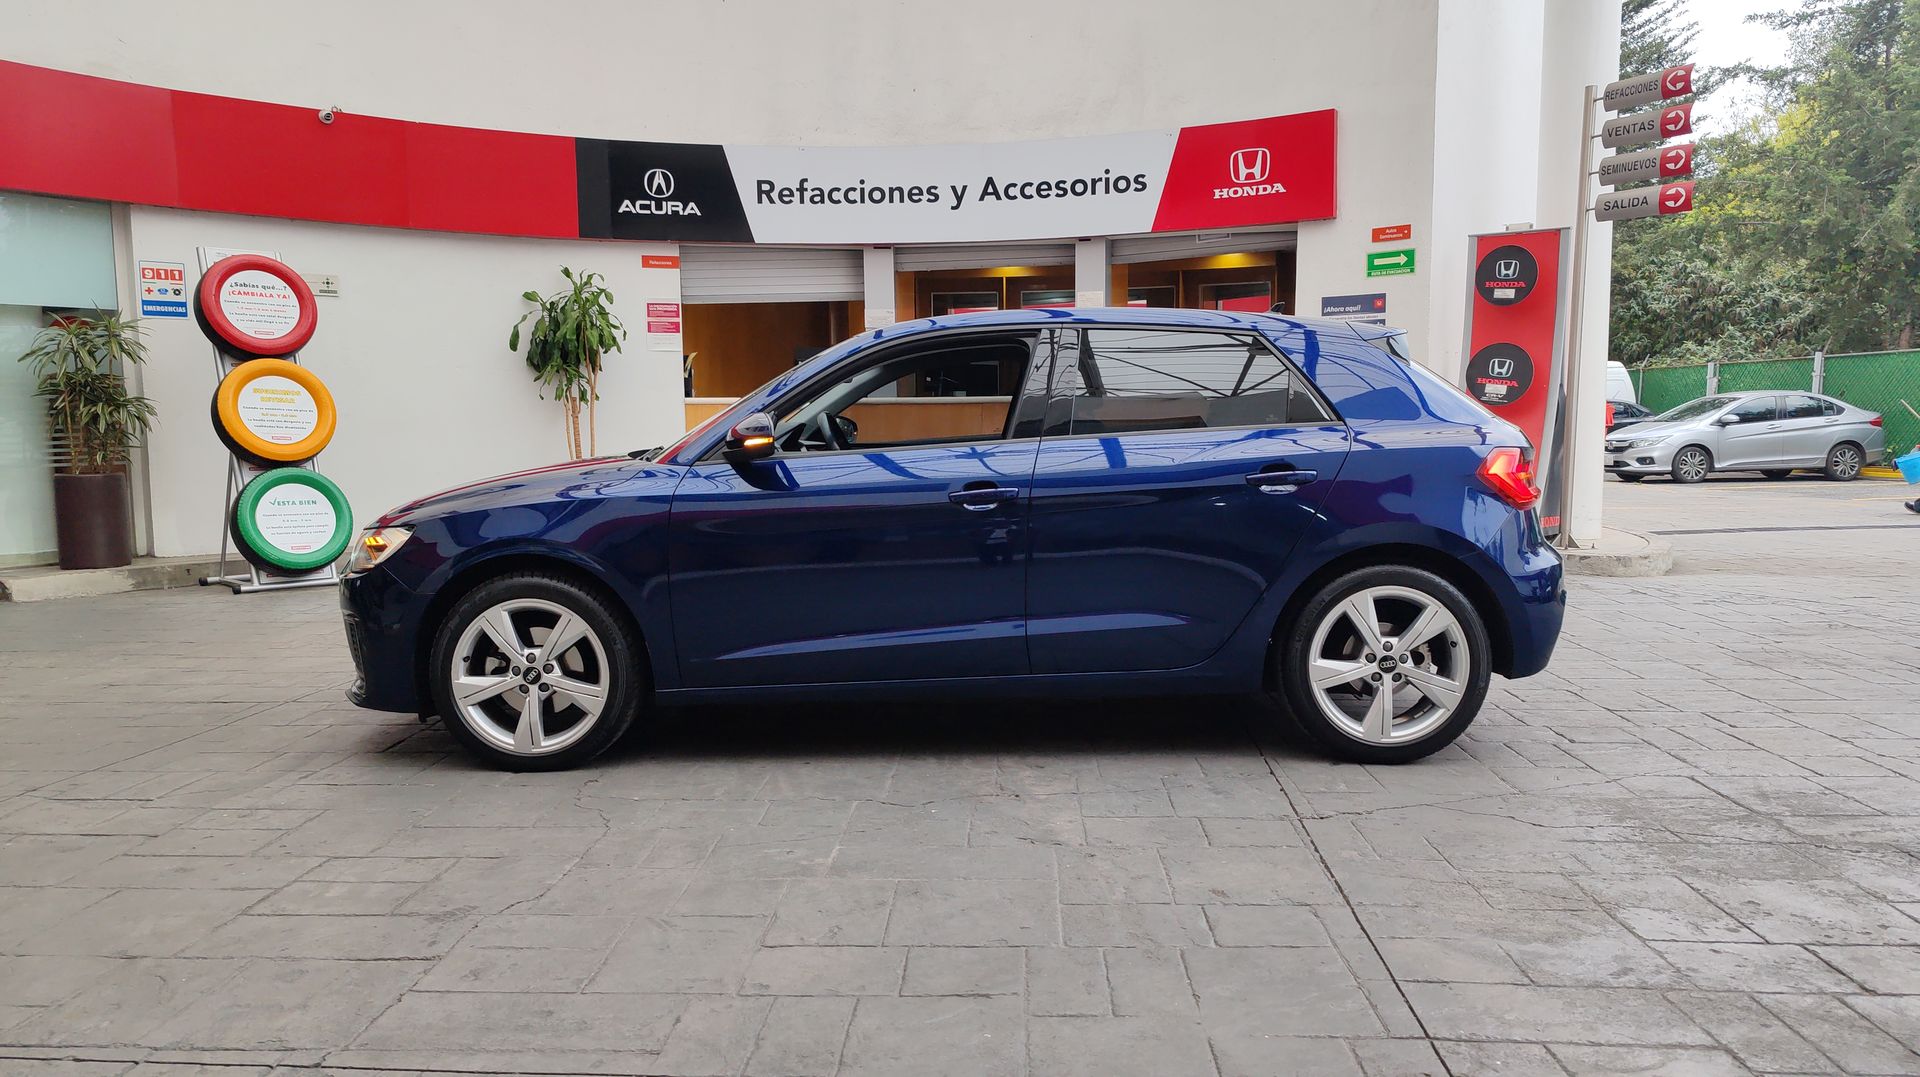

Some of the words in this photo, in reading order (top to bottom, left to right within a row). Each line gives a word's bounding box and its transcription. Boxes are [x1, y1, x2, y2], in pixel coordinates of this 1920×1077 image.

[1604, 79, 1659, 101] REFACCIONES
[1607, 119, 1655, 138] VENTAS
[1600, 157, 1657, 176] SEMINUEVOS
[755, 177, 940, 206] Refacciones
[949, 183, 968, 210] y
[978, 168, 1148, 202] Accesorios
[1213, 183, 1287, 199] HONDA
[618, 199, 702, 216] ACURA
[1603, 196, 1649, 212] SALIDA
[144, 269, 180, 280] 911
[143, 305, 186, 313] EMERGENCIAS
[1476, 377, 1519, 387] HONDA
